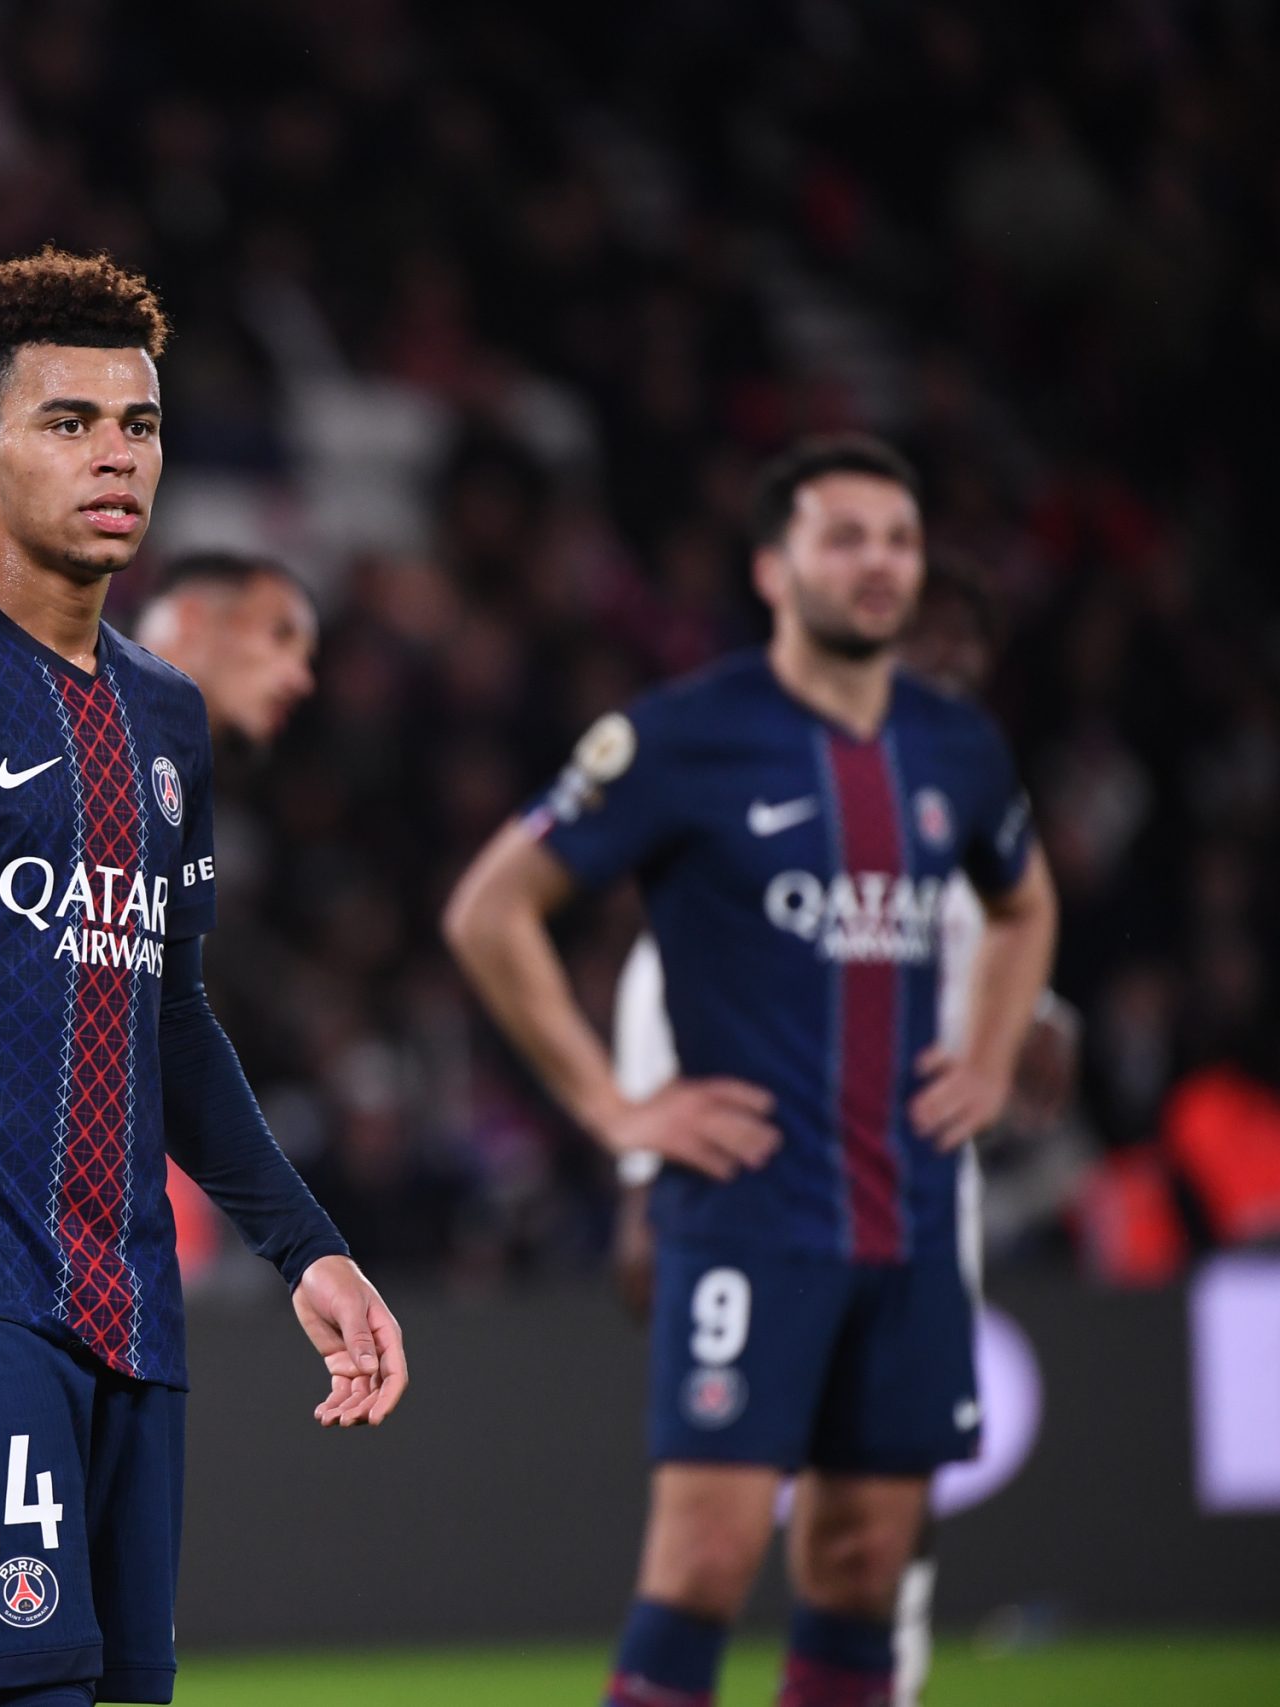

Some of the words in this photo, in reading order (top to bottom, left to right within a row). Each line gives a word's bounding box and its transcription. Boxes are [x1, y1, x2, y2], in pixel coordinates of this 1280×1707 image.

[53, 925, 165, 979] AIRWAYS
[690, 1265, 752, 1368] 9
[0, 1560, 44, 1580] PARIS
